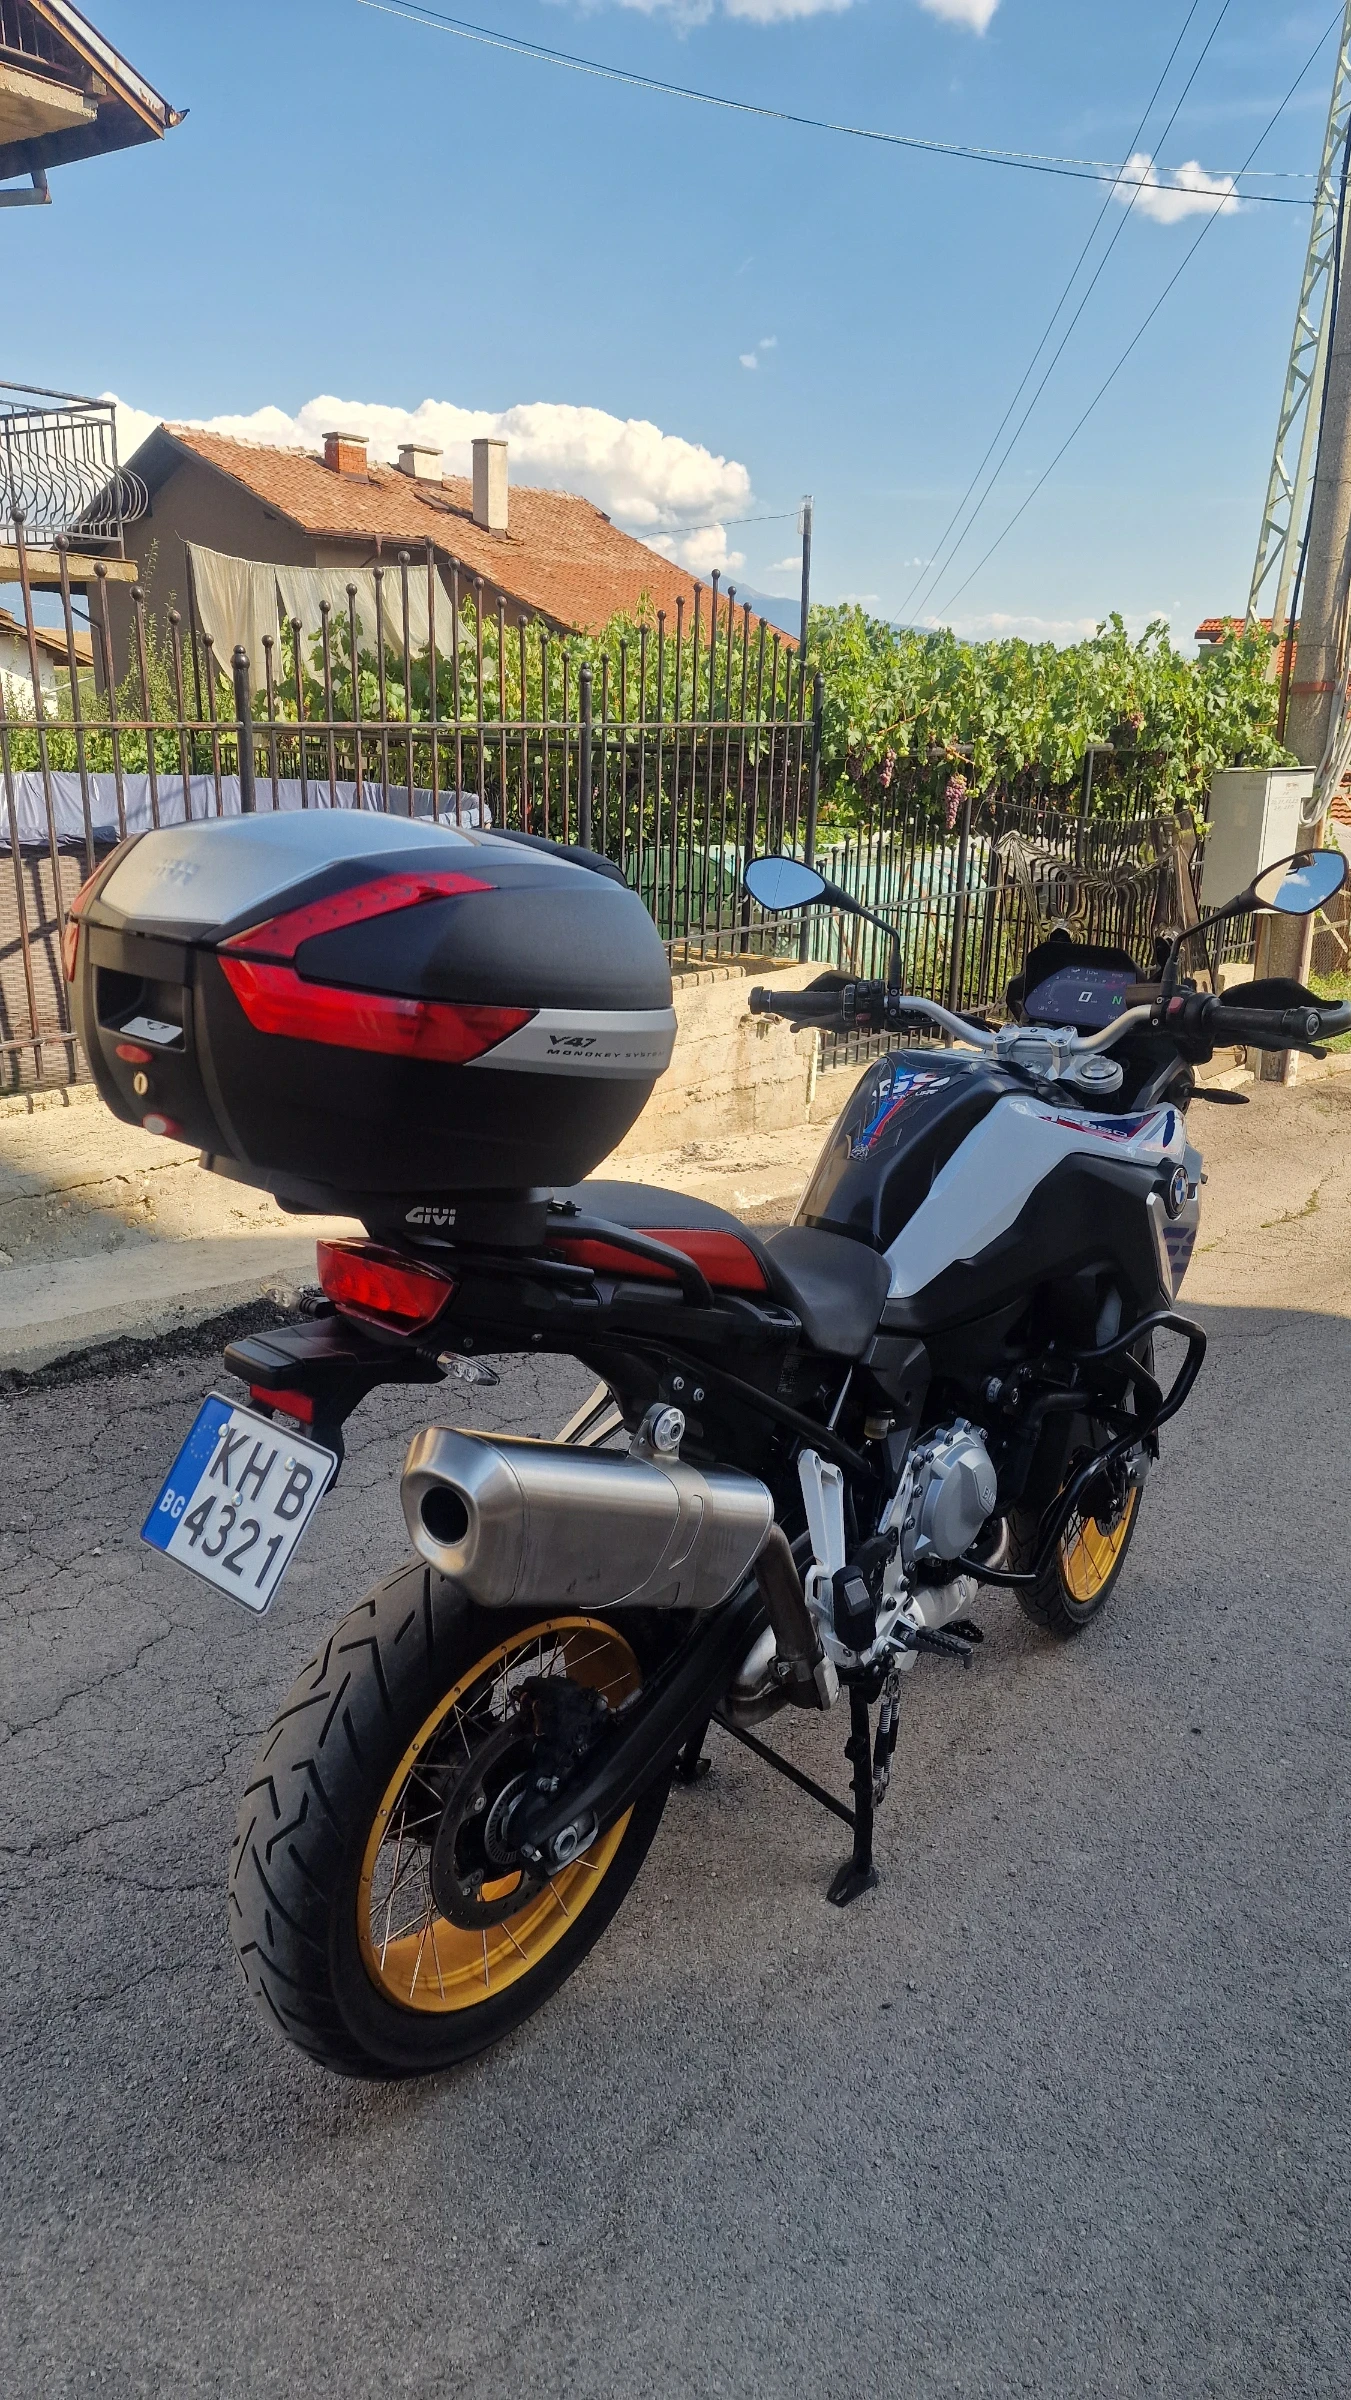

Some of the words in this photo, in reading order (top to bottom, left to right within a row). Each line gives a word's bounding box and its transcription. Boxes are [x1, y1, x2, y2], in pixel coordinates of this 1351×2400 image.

[1111, 995, 1123, 1005] N
[549, 1035, 597, 1049] V47
[546, 1049, 621, 1058] MONOKEY
[405, 1206, 457, 1226] GIVI
[159, 1488, 186, 1519] BG
[183, 1495, 284, 1589] 4321
